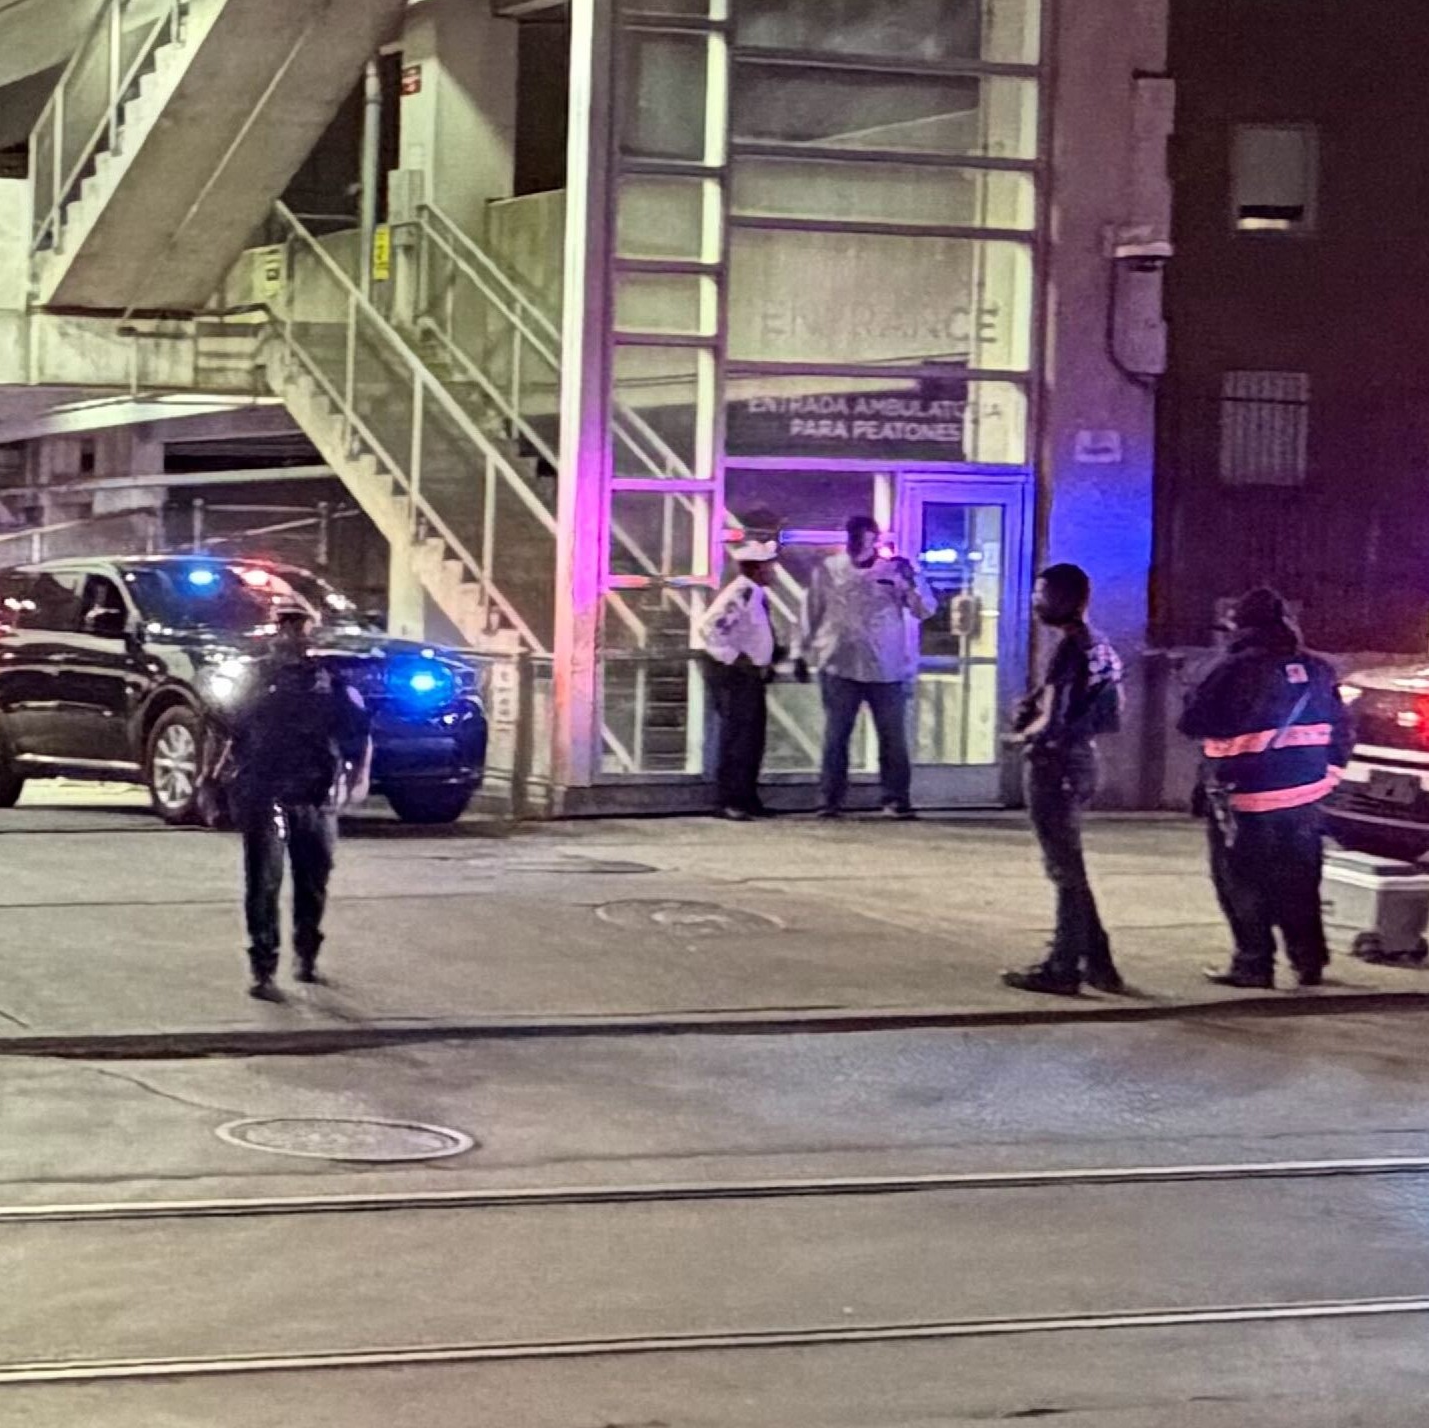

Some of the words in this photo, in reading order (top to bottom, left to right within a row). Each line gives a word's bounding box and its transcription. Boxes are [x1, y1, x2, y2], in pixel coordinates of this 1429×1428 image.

[748, 395, 848, 415] ENTRADA
[854, 398, 1001, 418] AMBULATOA
[790, 418, 848, 439] PARA
[852, 420, 962, 442] PEATONES
